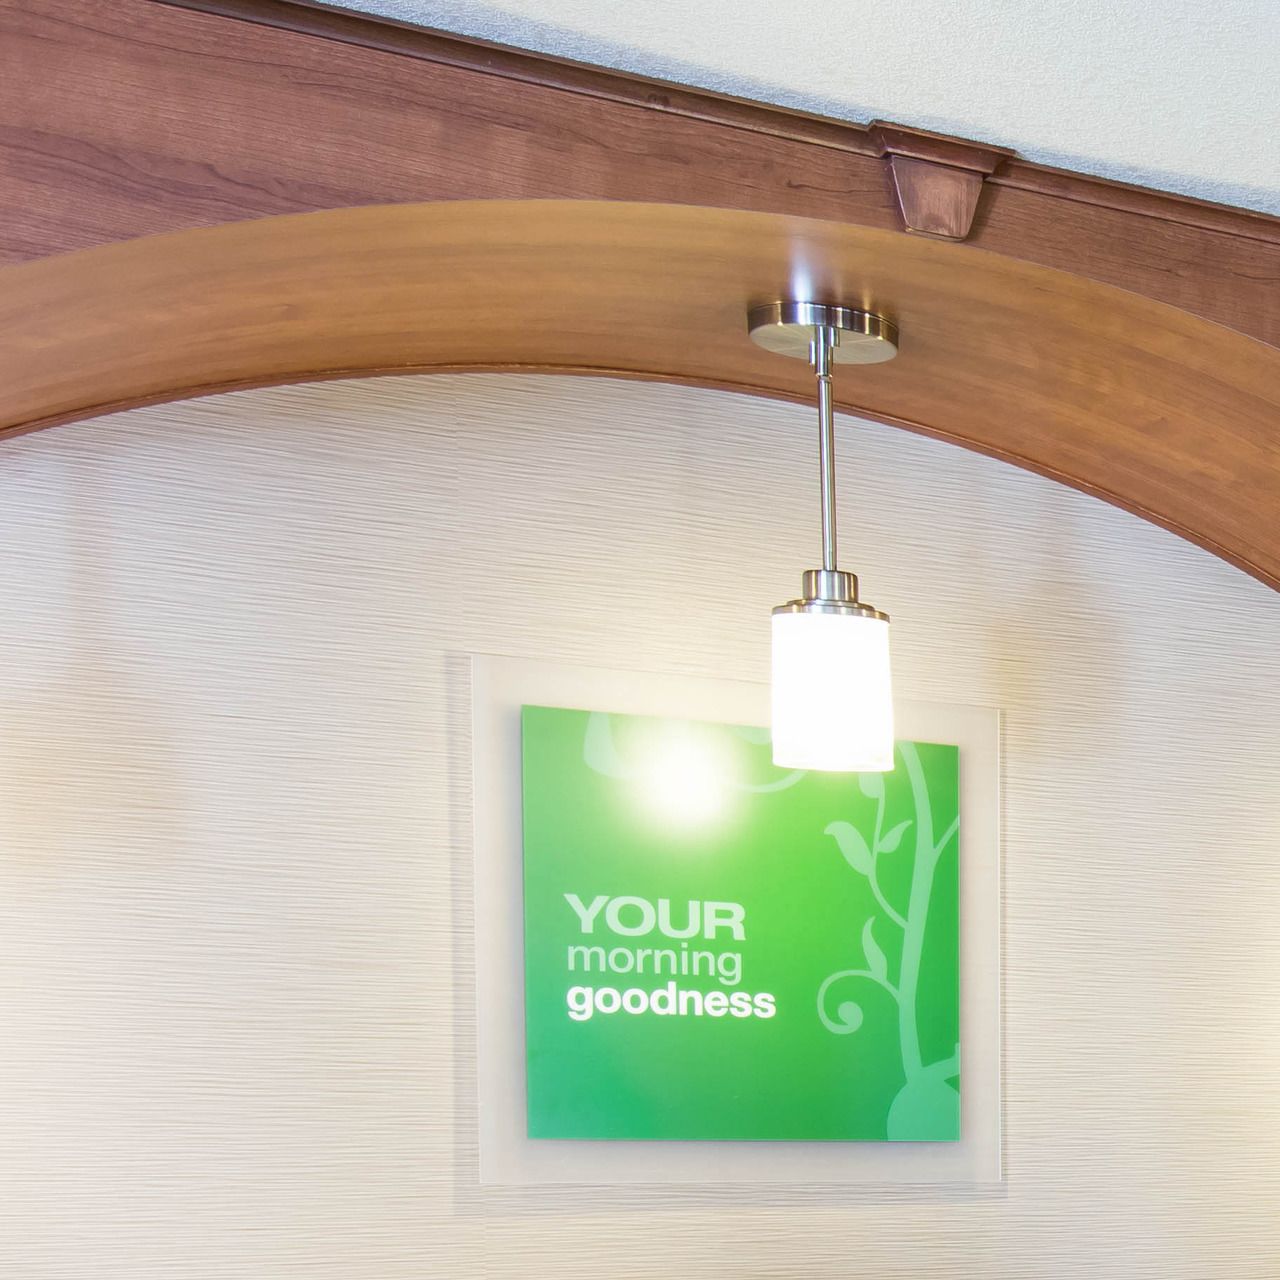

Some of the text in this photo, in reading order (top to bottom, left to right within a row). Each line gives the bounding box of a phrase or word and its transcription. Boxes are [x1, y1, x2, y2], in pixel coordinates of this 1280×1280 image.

[563, 893, 747, 941] YOUR
[567, 942, 742, 986] morning
[566, 981, 777, 1021] goodness
